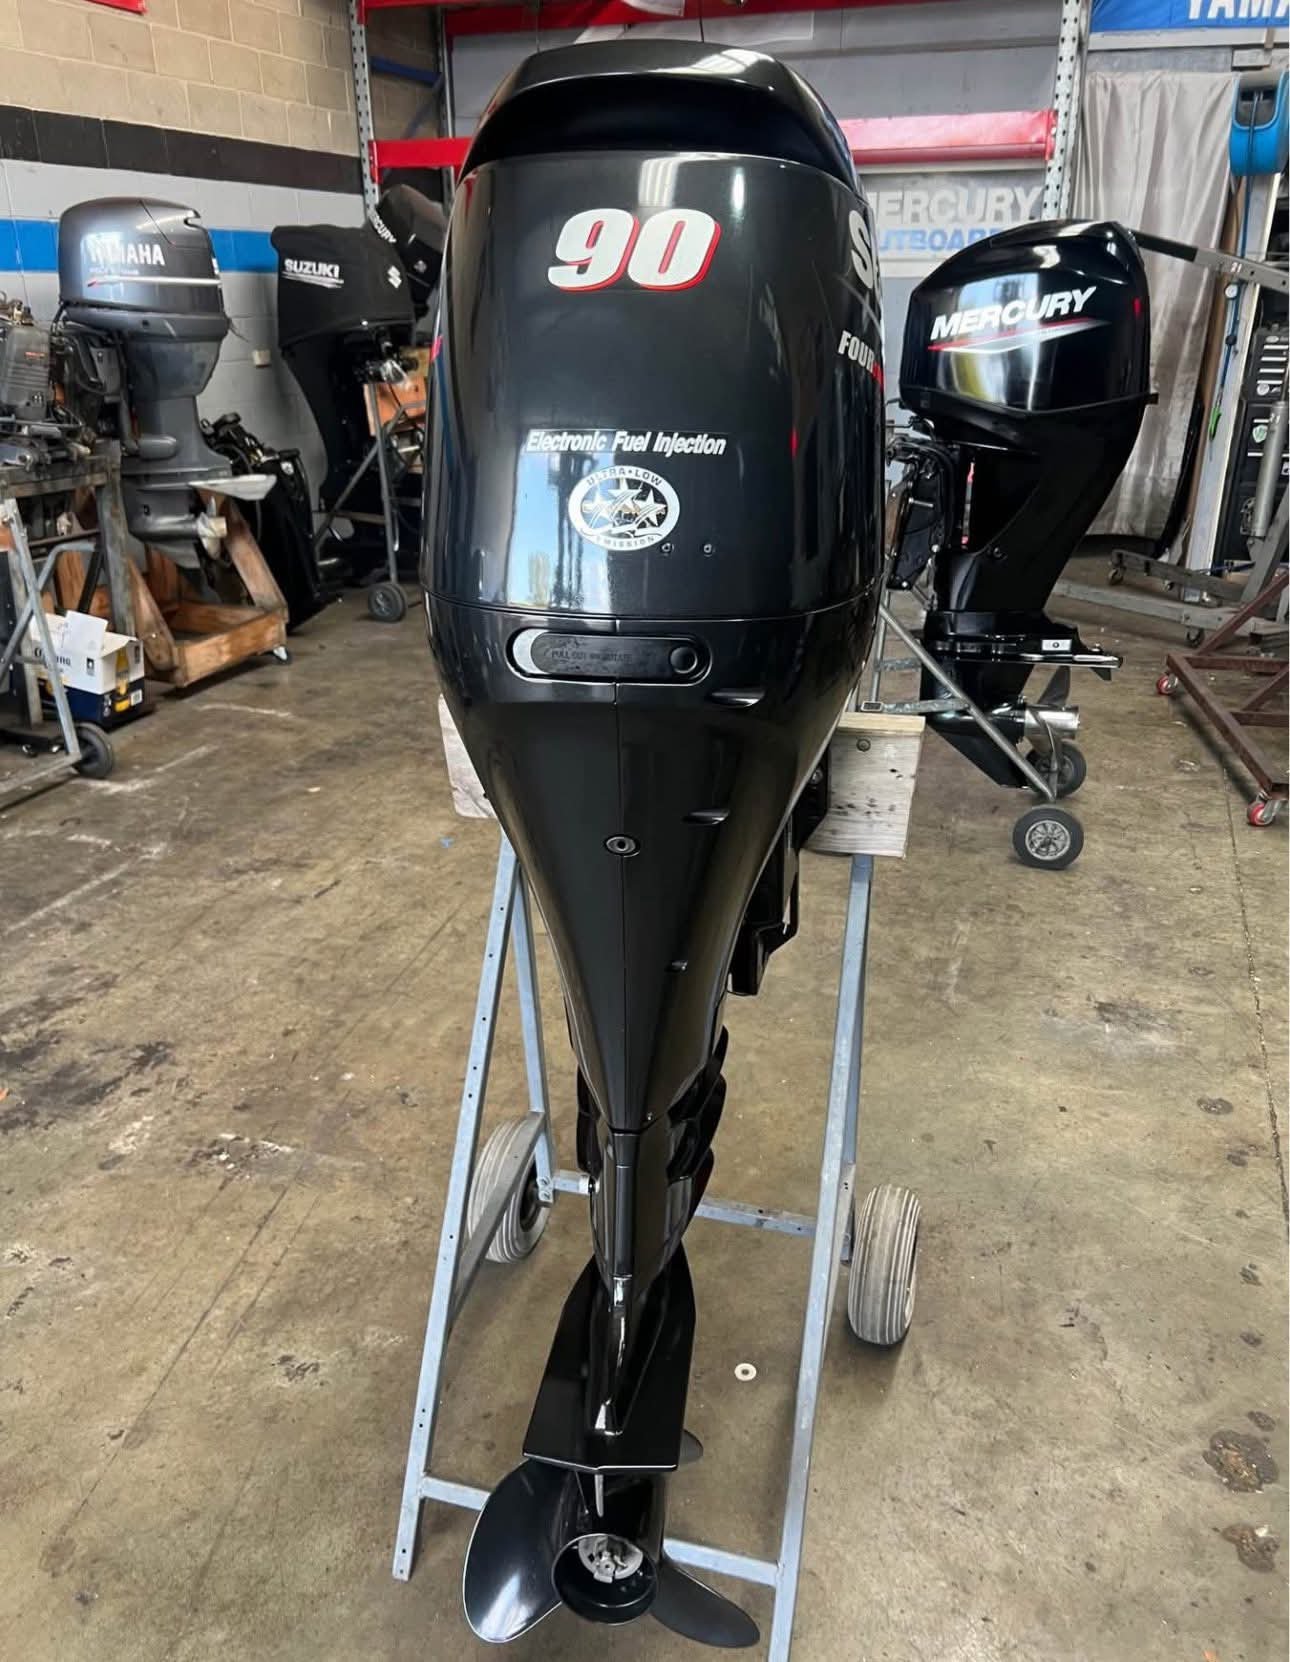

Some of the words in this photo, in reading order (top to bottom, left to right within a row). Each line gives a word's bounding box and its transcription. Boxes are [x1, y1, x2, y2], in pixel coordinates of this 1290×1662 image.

[866, 186, 1044, 223] ERCURY
[548, 208, 721, 292] 90
[284, 258, 340, 278] SUZUKI
[930, 286, 1097, 340] MERCURY
[526, 431, 607, 452] Electronic
[611, 431, 652, 452] Fuel
[653, 432, 726, 457] Injection
[634, 468, 662, 487] LOW
